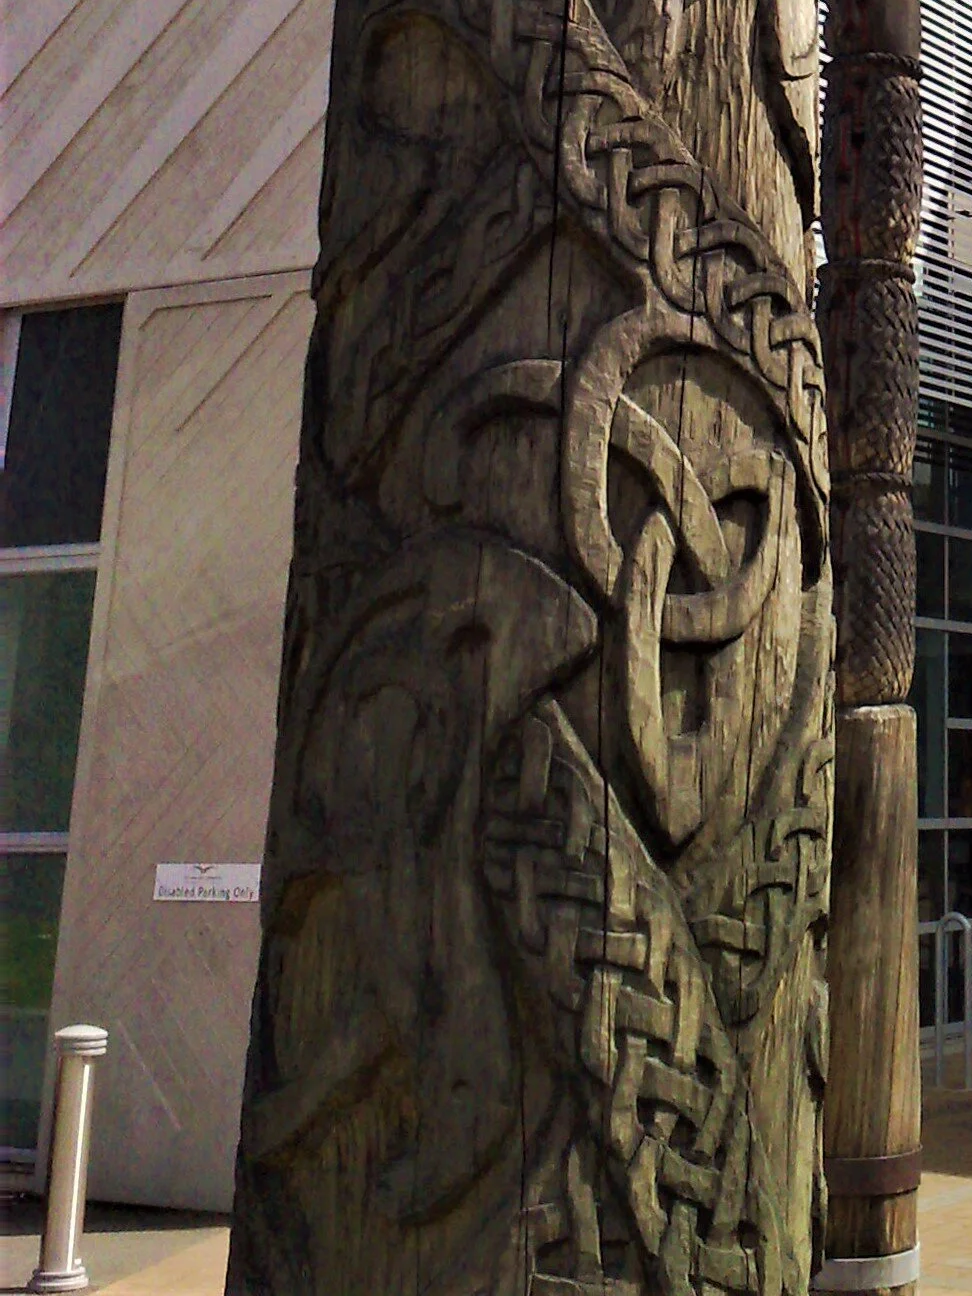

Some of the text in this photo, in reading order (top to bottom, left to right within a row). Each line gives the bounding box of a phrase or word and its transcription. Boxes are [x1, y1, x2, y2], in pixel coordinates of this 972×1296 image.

[159, 886, 254, 900] Disabled Parking Only
